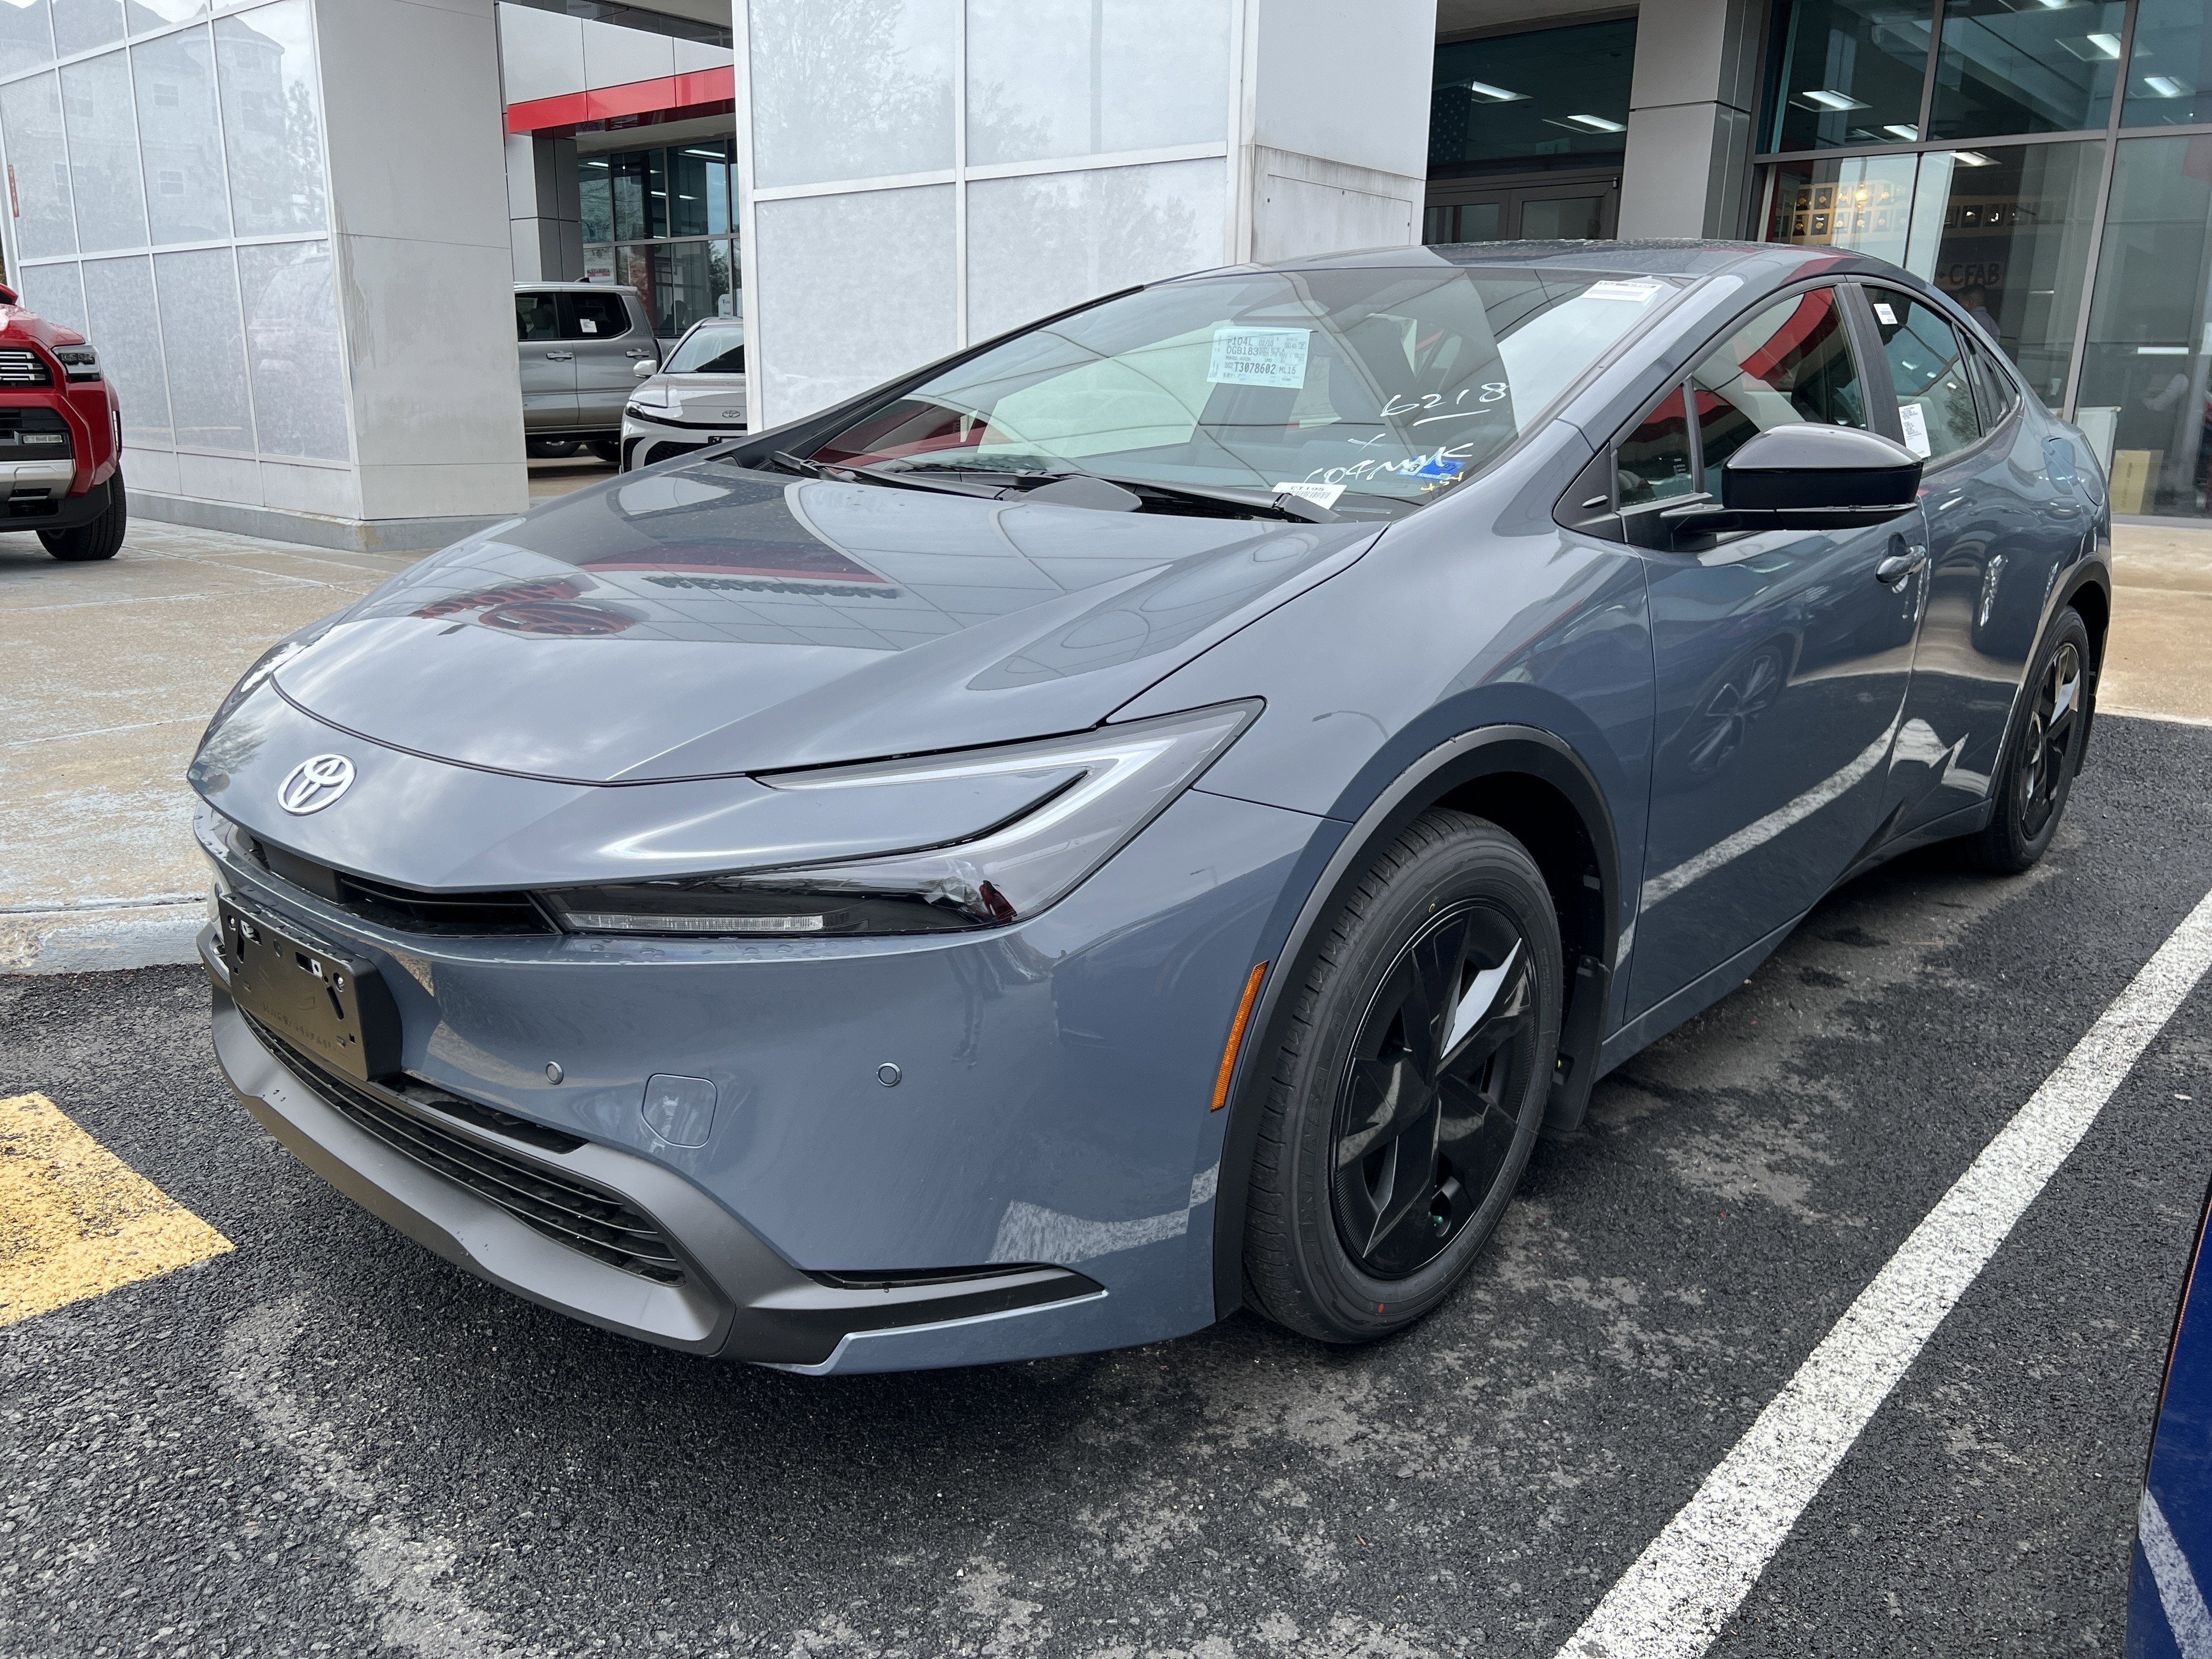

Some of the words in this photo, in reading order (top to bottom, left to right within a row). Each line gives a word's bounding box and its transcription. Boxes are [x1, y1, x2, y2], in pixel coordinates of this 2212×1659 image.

[1234, 361, 1276, 374] T3078602
[1279, 366, 1296, 374] ML15
[1380, 382, 1509, 417] 6218
